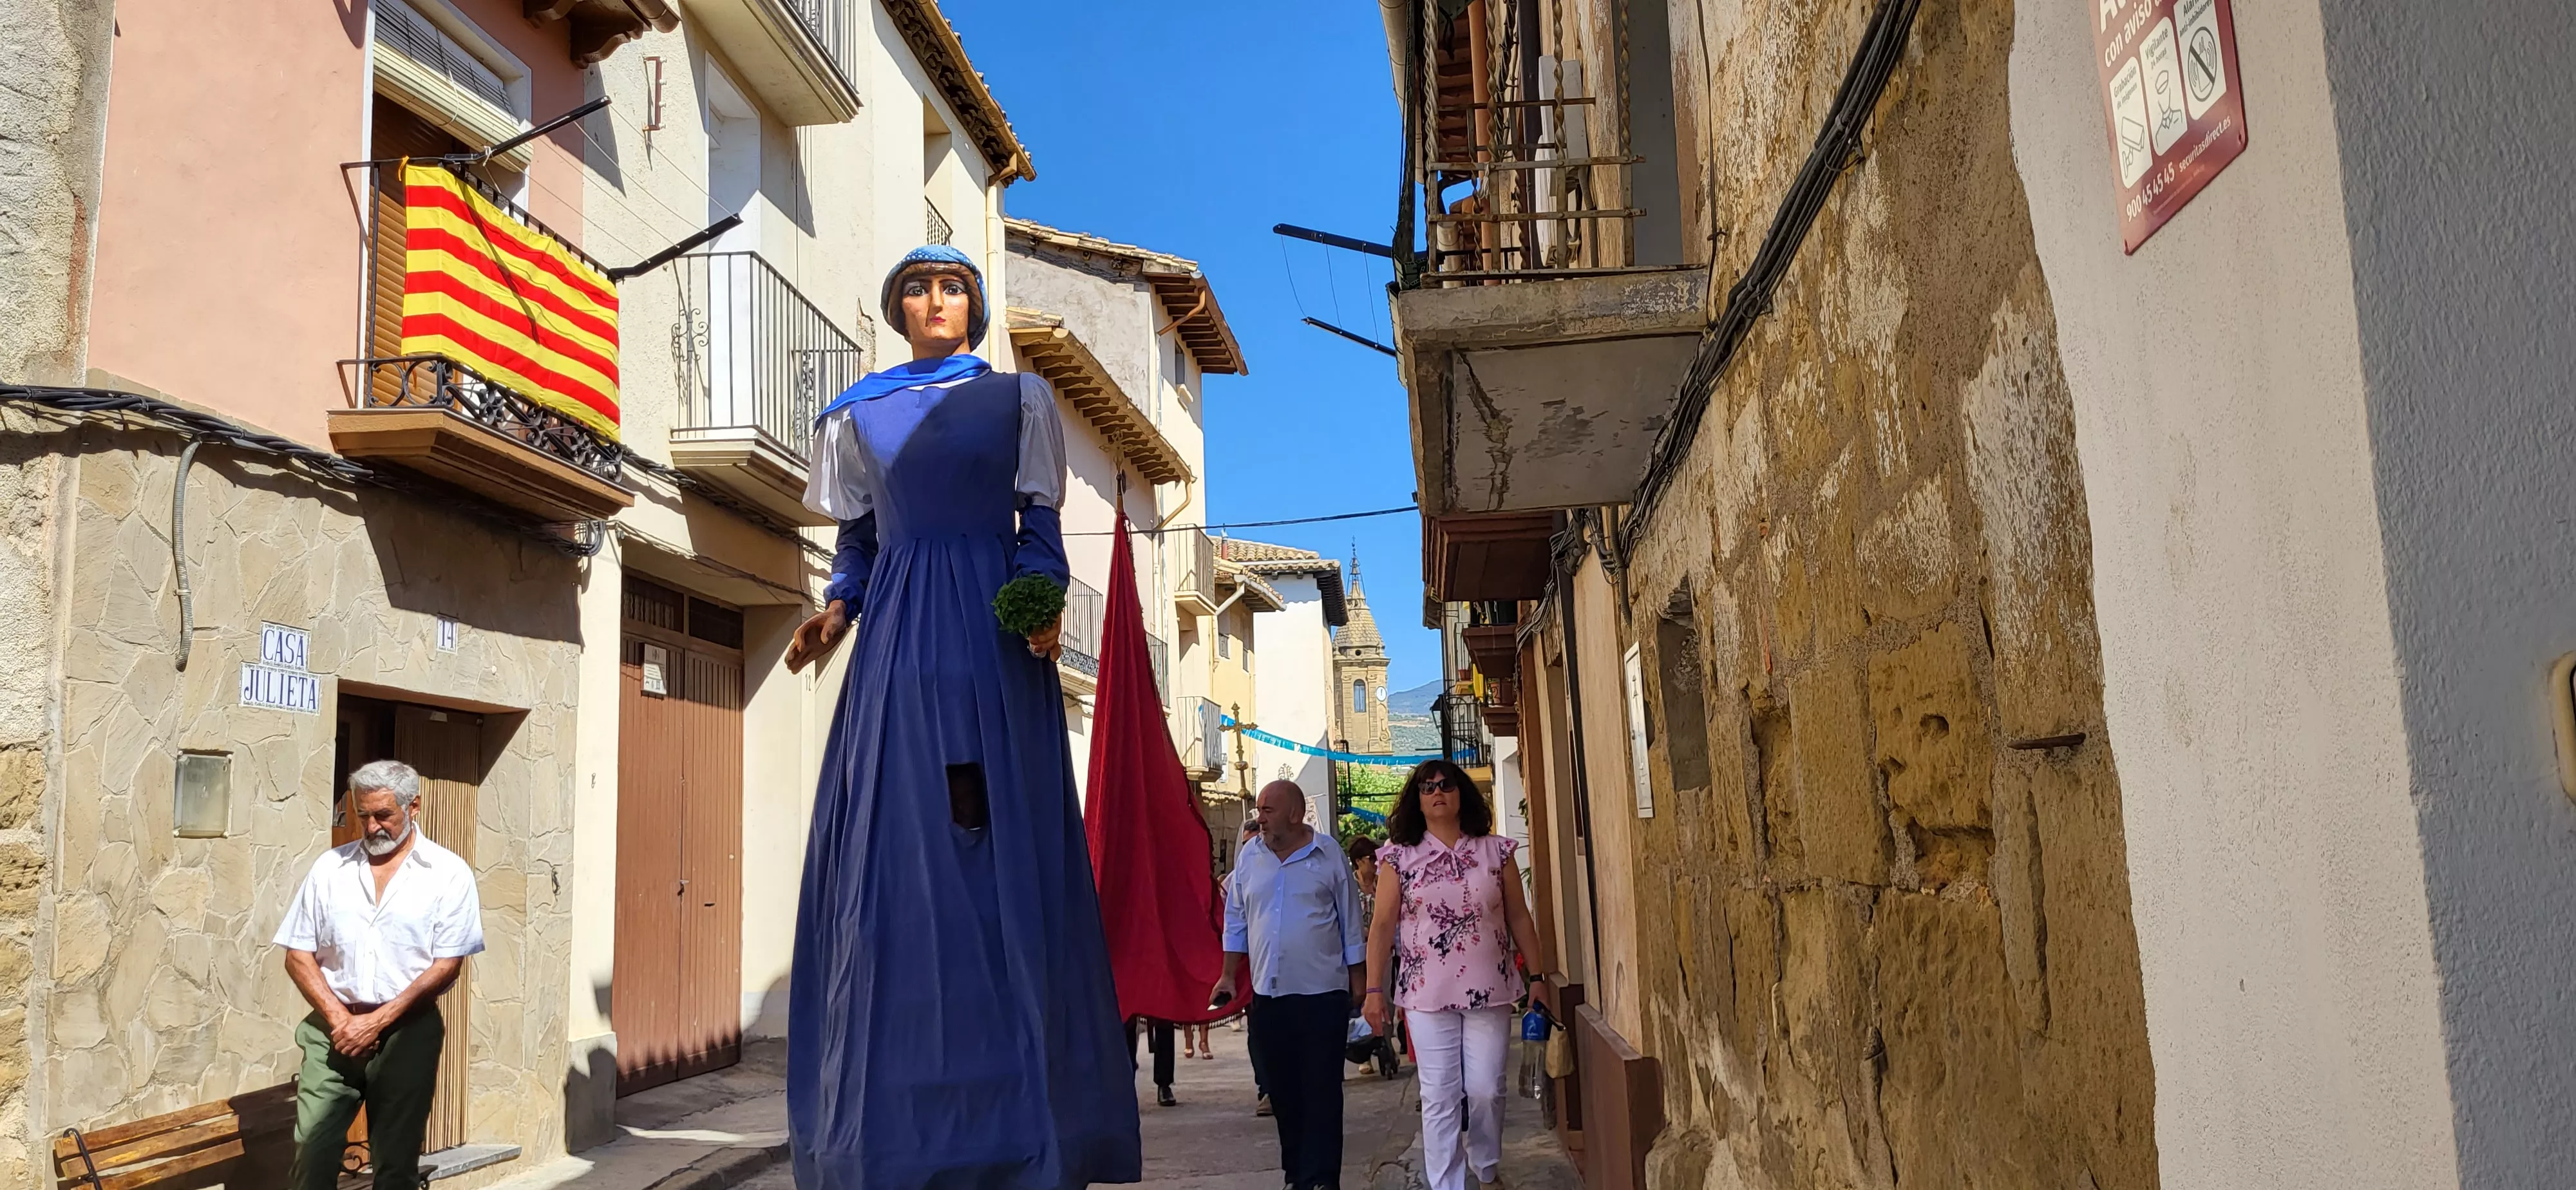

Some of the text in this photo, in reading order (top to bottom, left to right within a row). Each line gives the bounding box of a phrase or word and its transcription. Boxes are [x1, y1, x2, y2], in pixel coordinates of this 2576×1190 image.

[2105, 0, 2152, 68] con aviso
[2145, 28, 2168, 60] Vigilante
[2114, 66, 2137, 98] Grabación
[2126, 194, 2142, 222] 900
[2142, 183, 2153, 206] 45
[2153, 172, 2164, 195] 45
[2164, 162, 2175, 185] 45
[2179, 115, 2231, 173] securitasdirect.es
[263, 629, 304, 666] CASA
[243, 669, 316, 710] JULIETA
